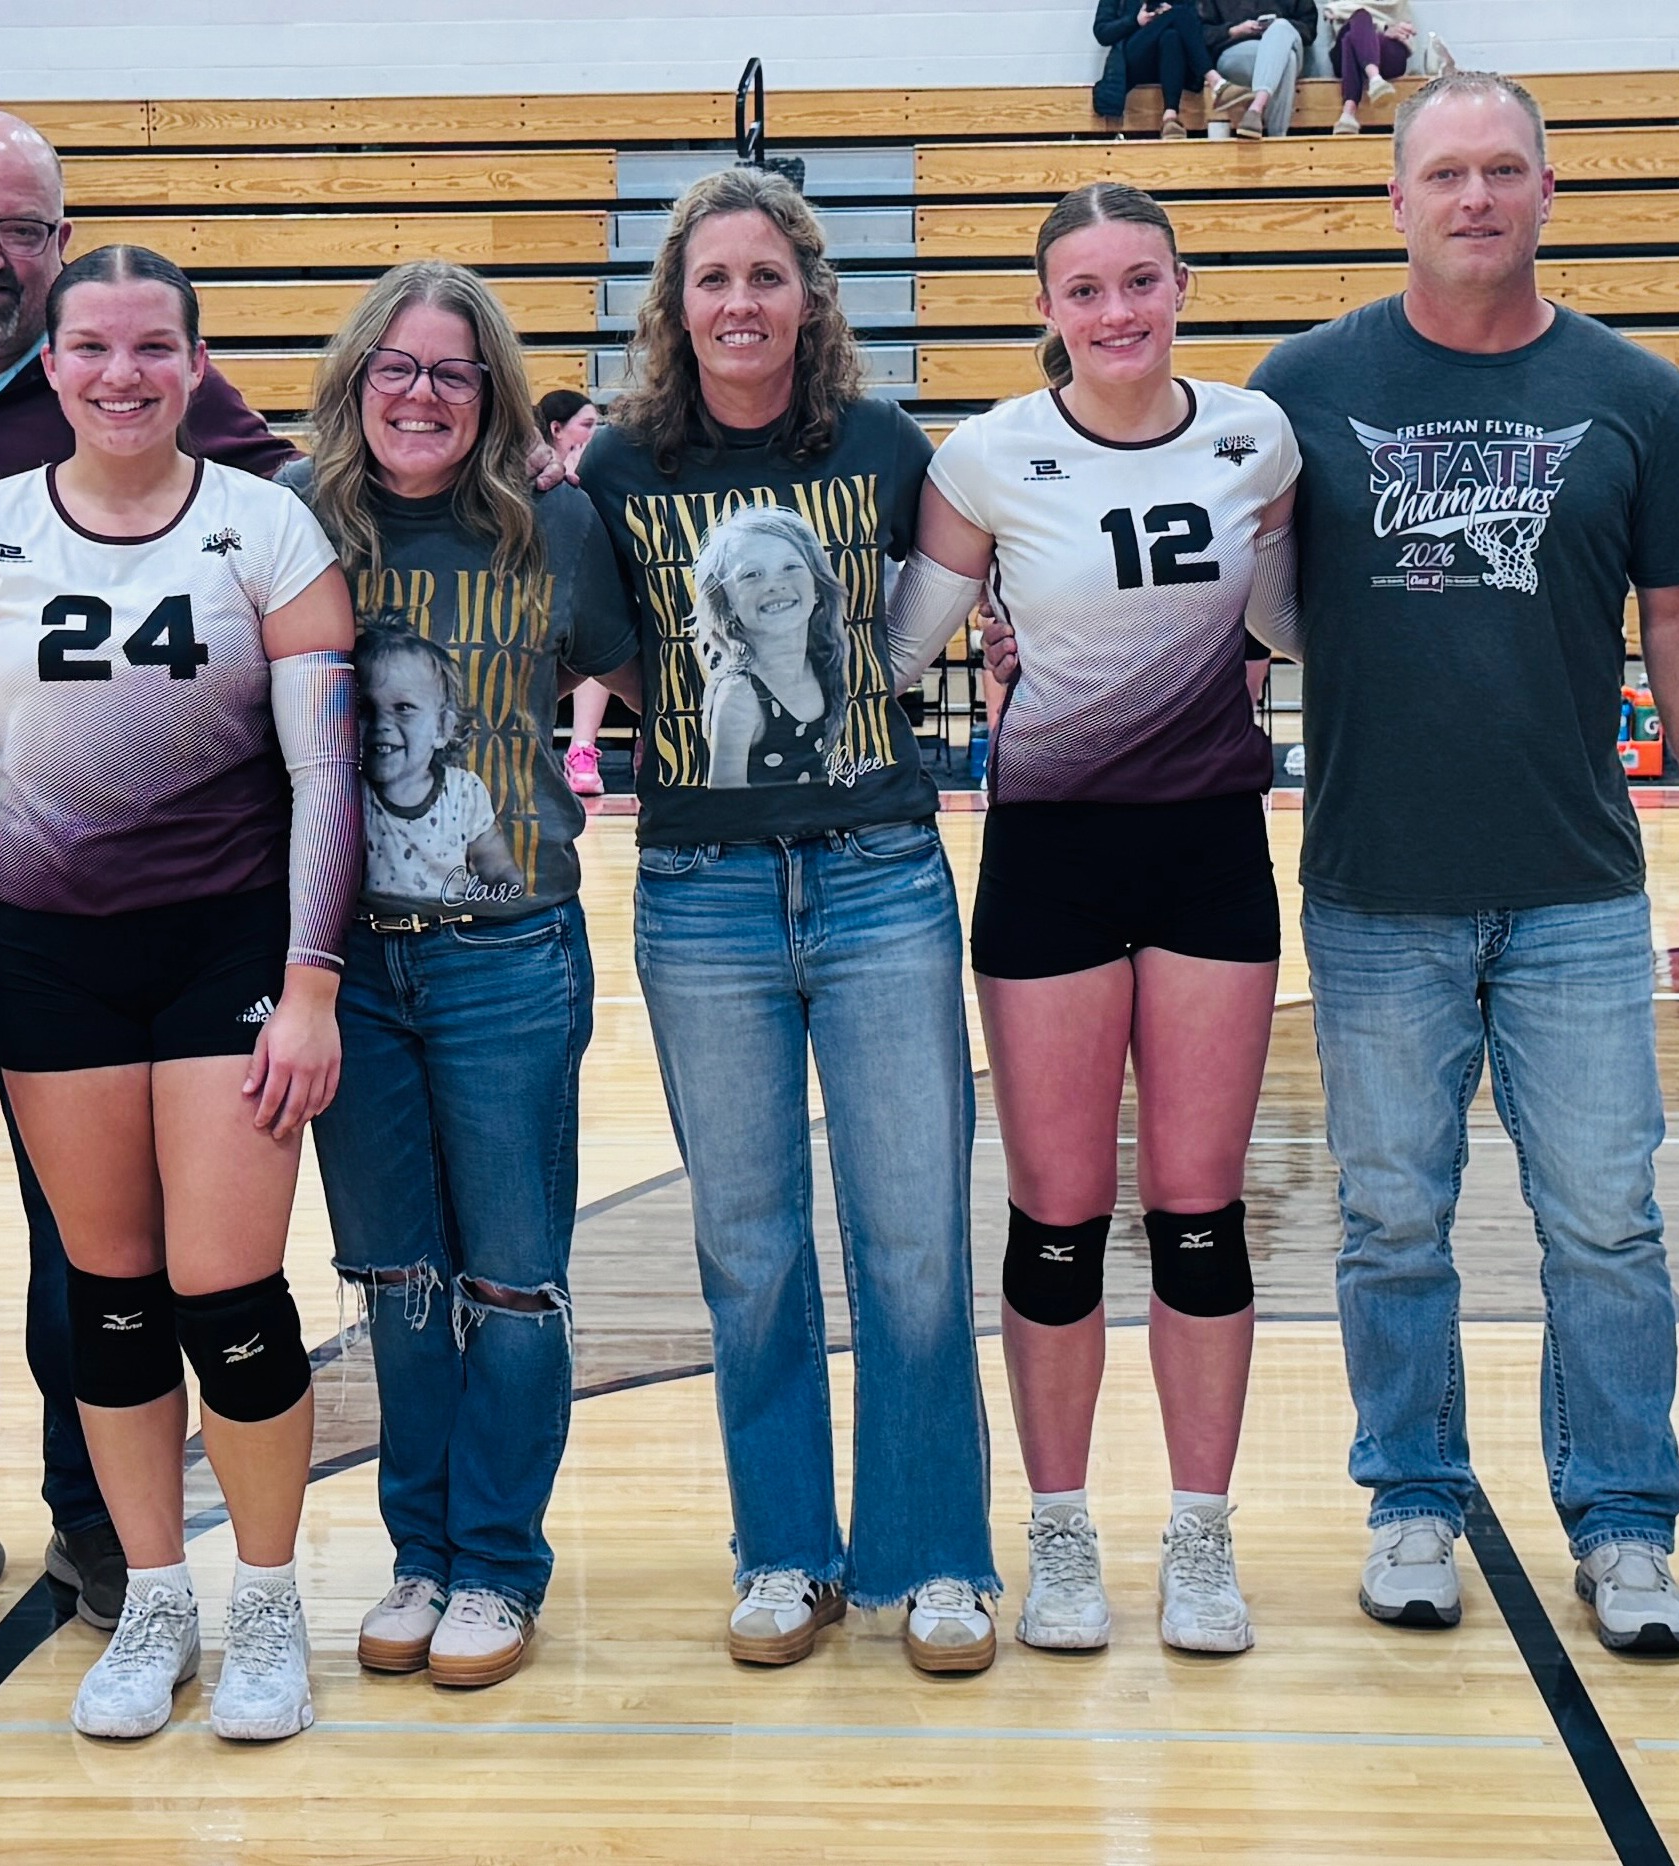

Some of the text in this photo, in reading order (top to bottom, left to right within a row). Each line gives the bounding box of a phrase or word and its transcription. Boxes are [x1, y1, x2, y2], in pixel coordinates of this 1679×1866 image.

[1397, 420, 1544, 440] FREEMAN FLYERS
[1370, 441, 1566, 495] STATE
[625, 487, 778, 566] SENI
[1373, 479, 1556, 538] Champions
[1100, 502, 1220, 590] 12
[1395, 542, 1456, 568] 2026
[38, 594, 209, 682] 24
[440, 865, 524, 908] Claire
